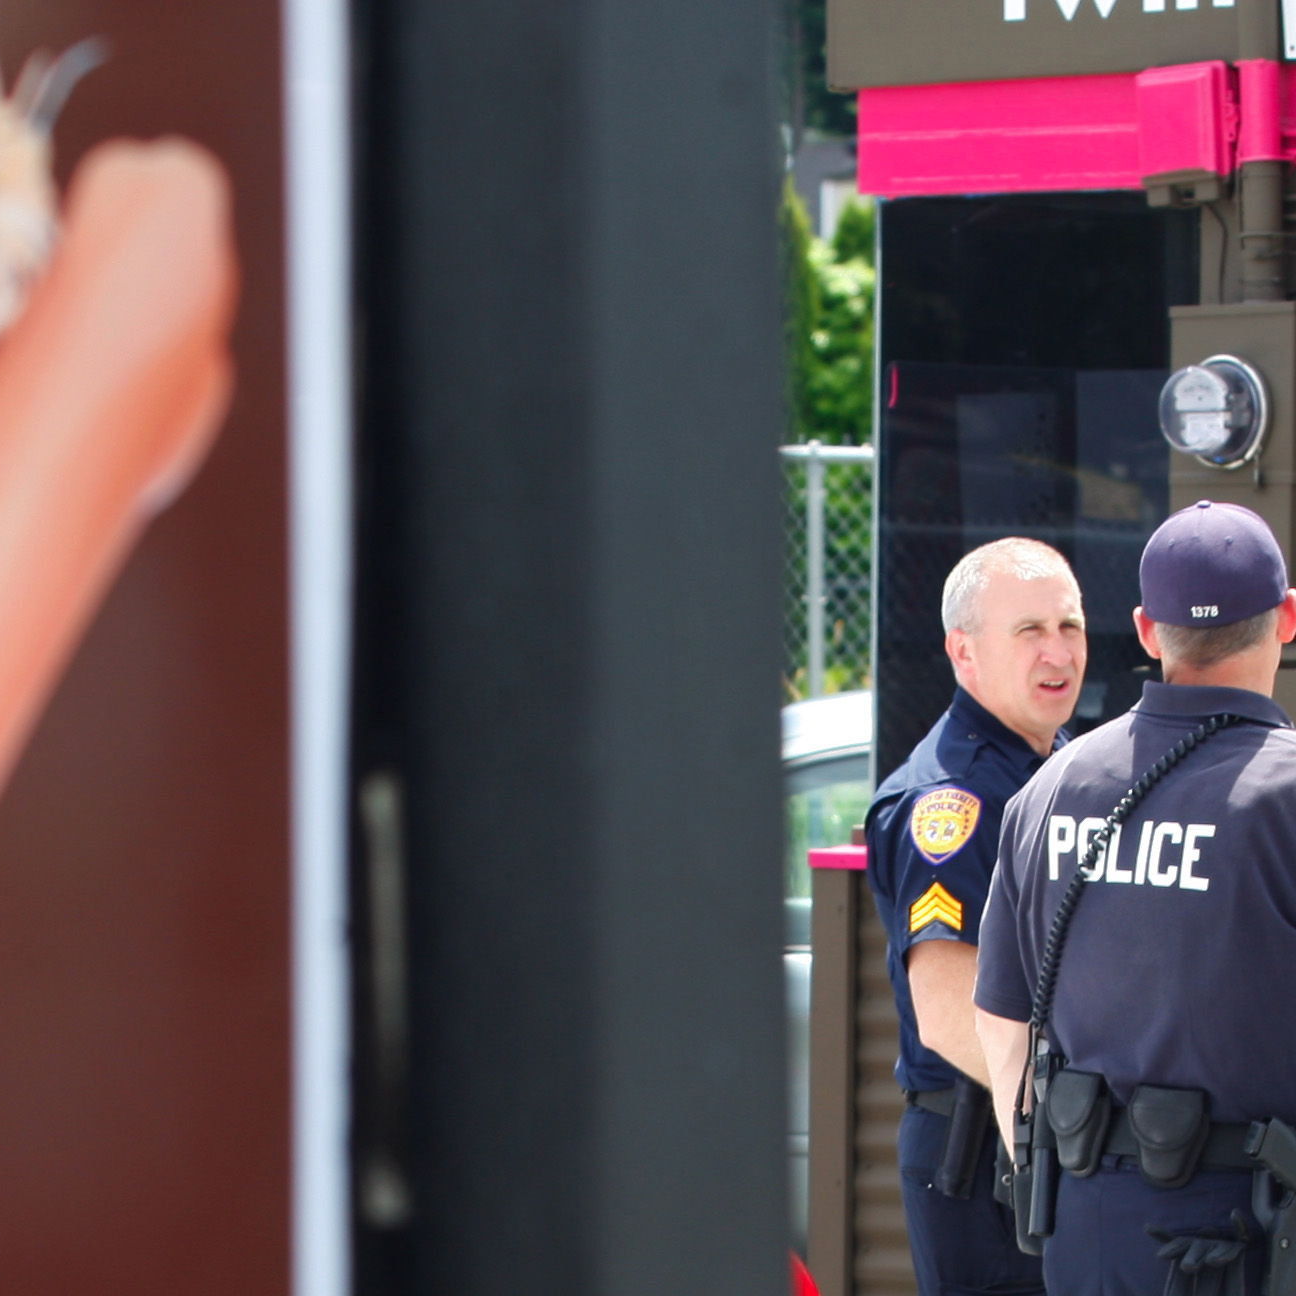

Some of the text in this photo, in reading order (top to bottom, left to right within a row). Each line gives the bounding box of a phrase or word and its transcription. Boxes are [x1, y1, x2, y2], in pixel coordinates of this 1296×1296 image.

[1191, 605, 1219, 618] 1378
[926, 802, 965, 814] POLICE
[1047, 815, 1217, 892] POLICE
